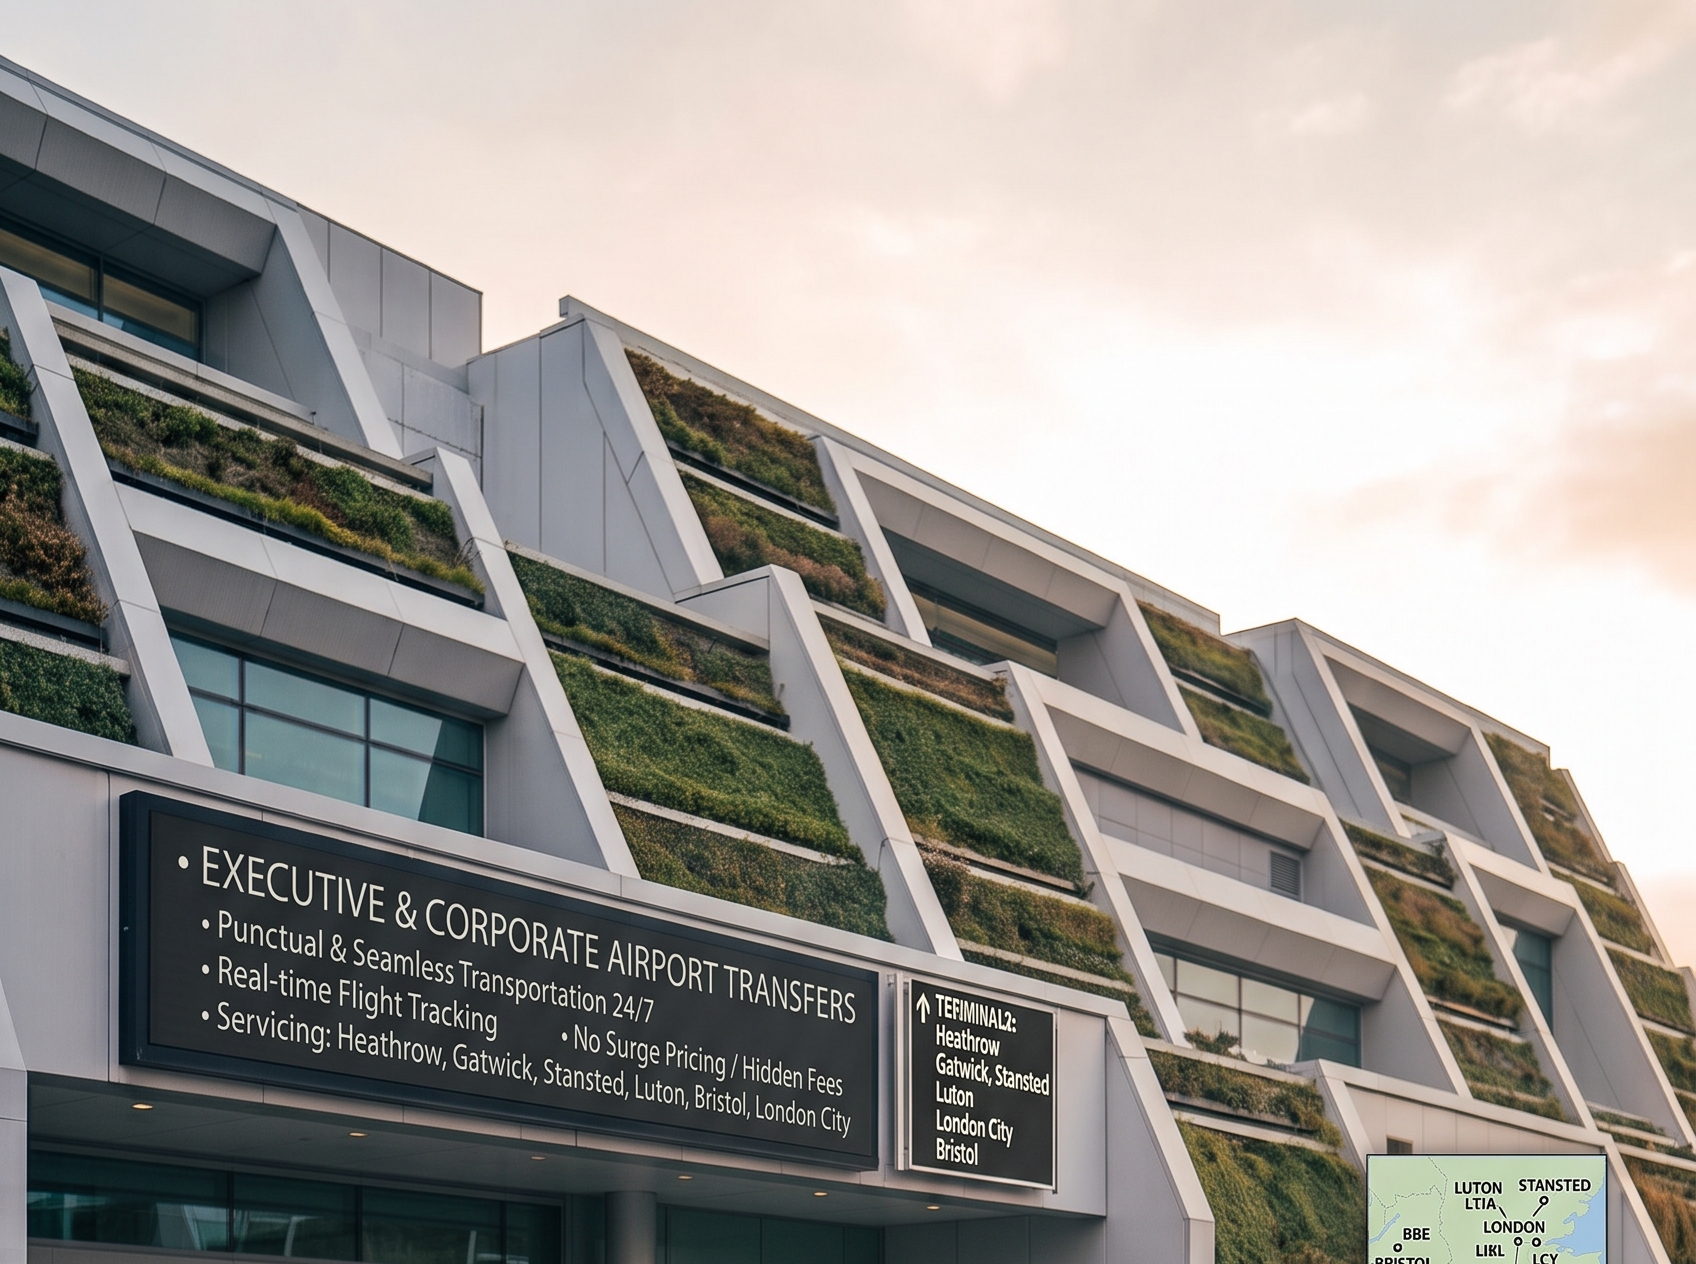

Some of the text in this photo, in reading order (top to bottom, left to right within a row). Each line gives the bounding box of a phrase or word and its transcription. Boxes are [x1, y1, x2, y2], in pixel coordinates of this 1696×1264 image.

[202, 845, 856, 1024] EXECUTIVE & CORPORATE AIRPORT TRANSFERS
[218, 909, 655, 1024] Punctual & Seamless Transportation 24/7
[218, 955, 497, 1042] Real-time Flight Tracking
[936, 1023, 1001, 1057] Heathrow
[217, 1001, 851, 1139] Servicing: Heathrow, Gatwick, Stansted, Luton, Bristol, London City
[574, 1023, 843, 1097] No Surge Pricing / Hidden Fees
[935, 1052, 1050, 1096] Gatwick, Stansted
[936, 1080, 974, 1108] Luton
[936, 1108, 1014, 1148] London City
[936, 1137, 979, 1166] Bristol
[1454, 1181, 1502, 1195] LUTON
[1518, 1178, 1591, 1192] STANSTED
[1403, 1227, 1431, 1241] BBE
[1483, 1220, 1545, 1234] LONDON
